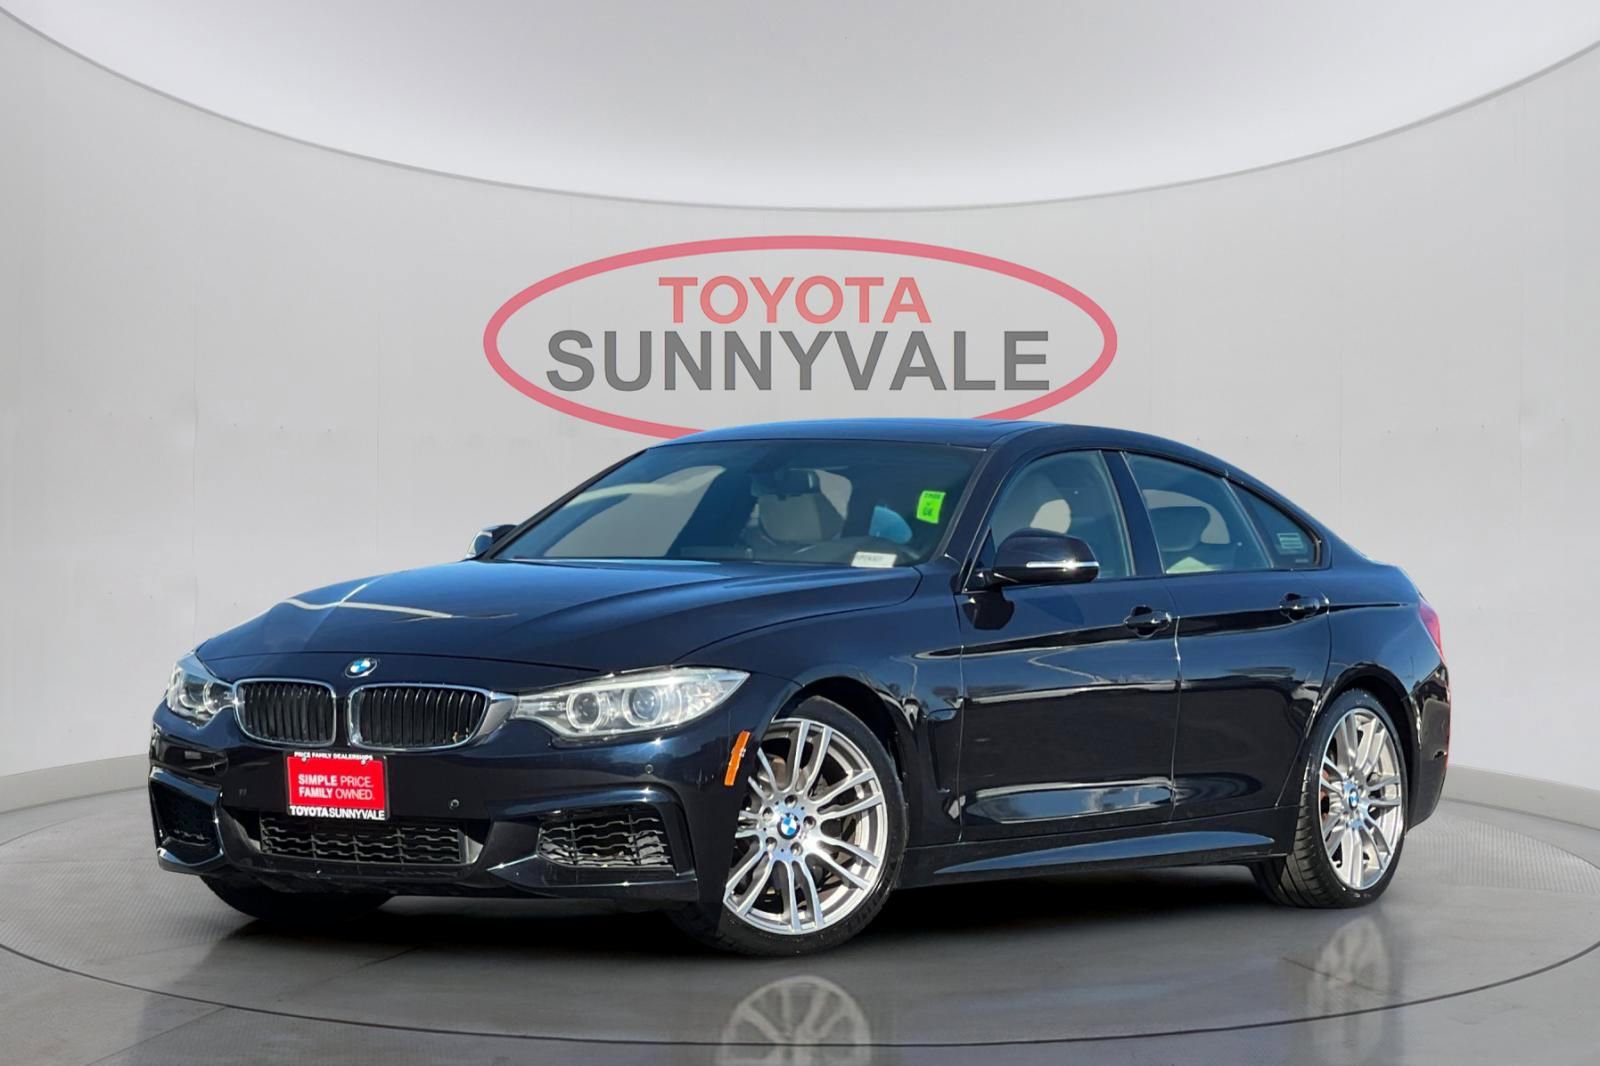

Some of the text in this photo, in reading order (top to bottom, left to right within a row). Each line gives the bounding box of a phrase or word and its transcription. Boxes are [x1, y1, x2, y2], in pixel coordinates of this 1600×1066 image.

[658, 276, 932, 325] TOYOTA
[546, 330, 1050, 392] SUNNYVALE
[312, 752, 332, 760] FAMILY
[298, 774, 338, 786] SIMPLE
[298, 786, 333, 799] FAMILY
